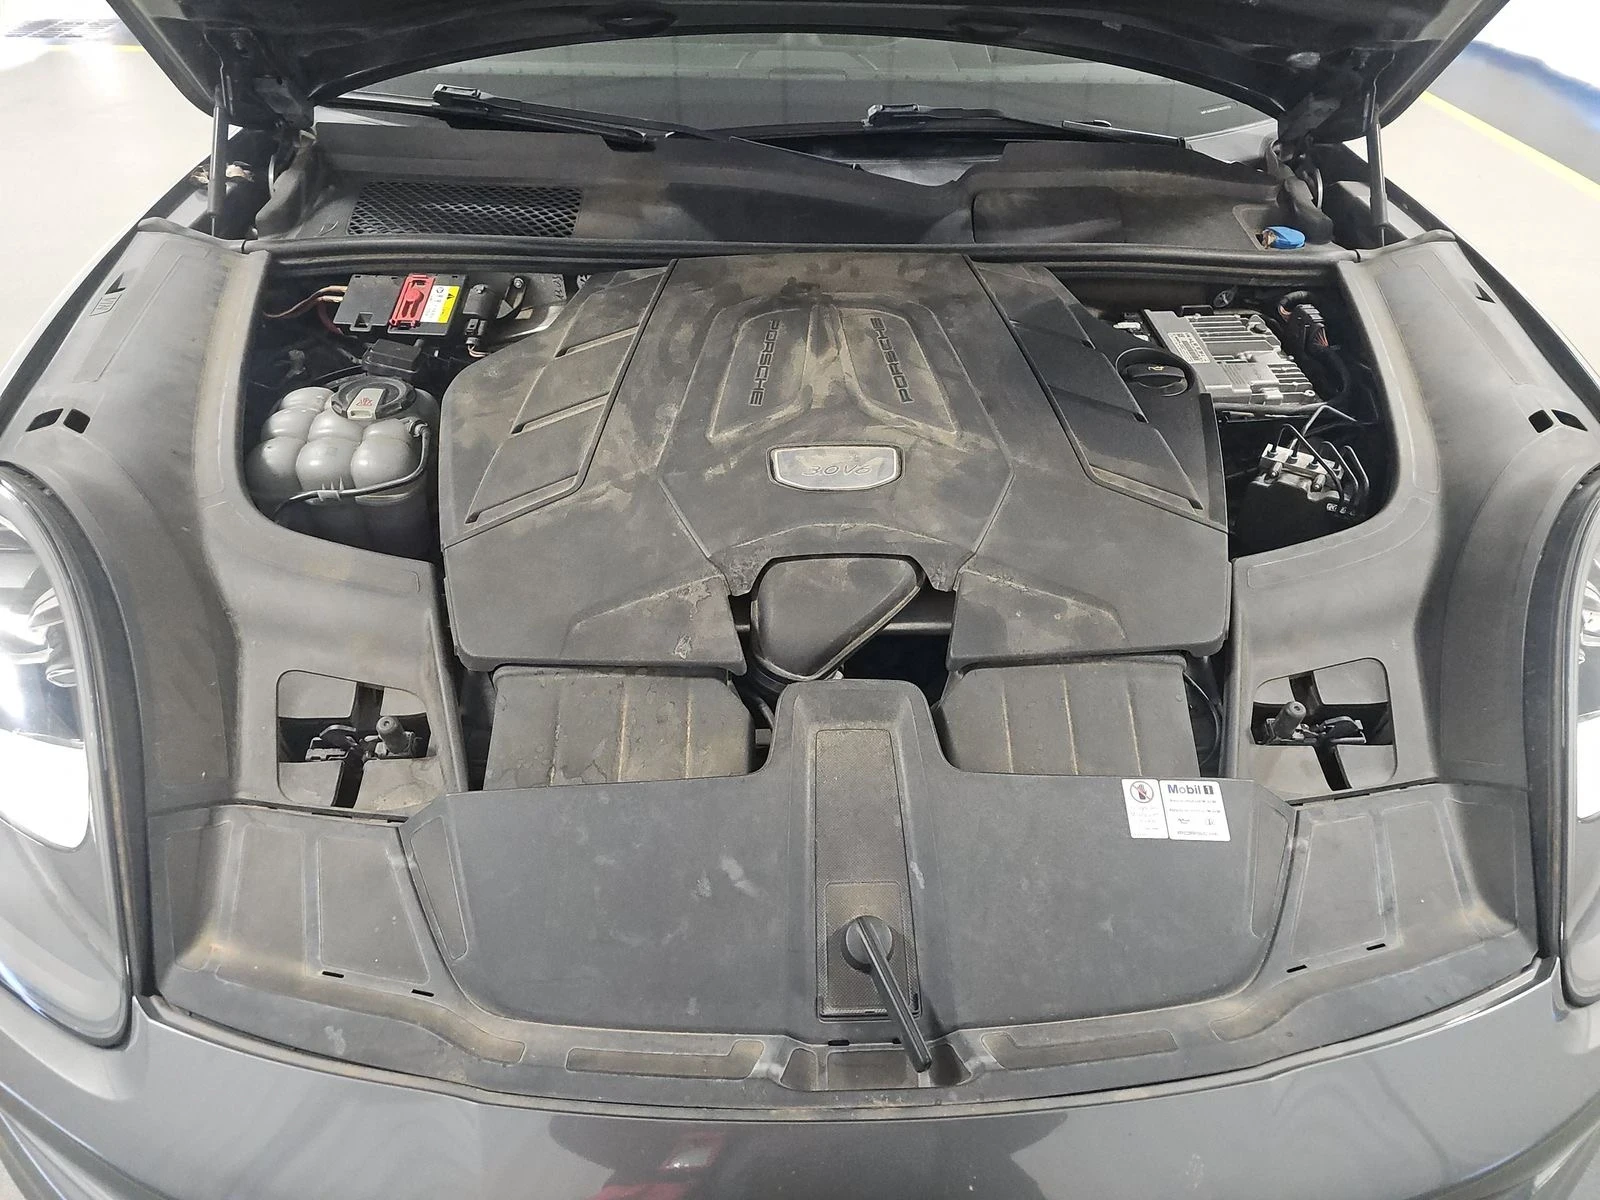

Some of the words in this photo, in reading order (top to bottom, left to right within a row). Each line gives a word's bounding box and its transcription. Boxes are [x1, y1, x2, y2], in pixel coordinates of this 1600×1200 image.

[749, 319, 781, 406] PORSCHE
[869, 317, 914, 403] PORSCHE
[1167, 784, 1201, 795] Mobil
